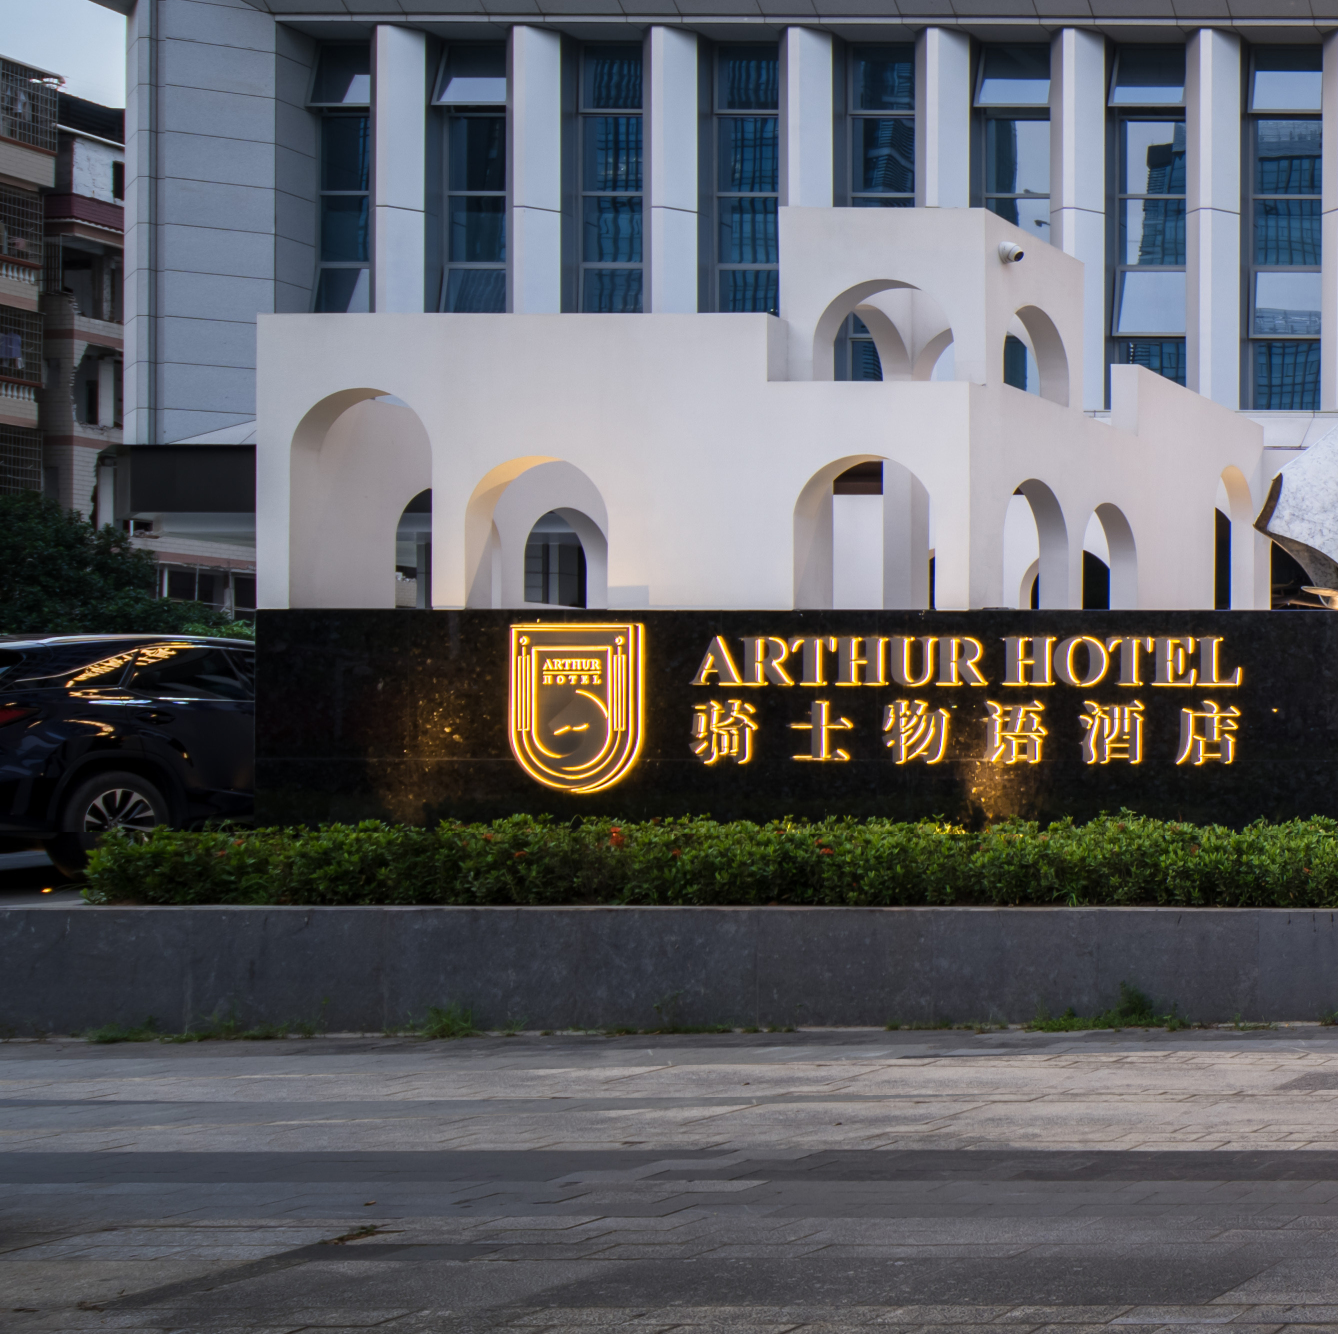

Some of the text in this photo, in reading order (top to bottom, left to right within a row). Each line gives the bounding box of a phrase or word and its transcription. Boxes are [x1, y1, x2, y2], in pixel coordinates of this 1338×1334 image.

[542, 658, 602, 670] ARTHUR
[688, 635, 1244, 687] ARTHUR HOTEL
[542, 675, 602, 685] HOTEL
[688, 699, 1243, 767] 骑士物语酒店
